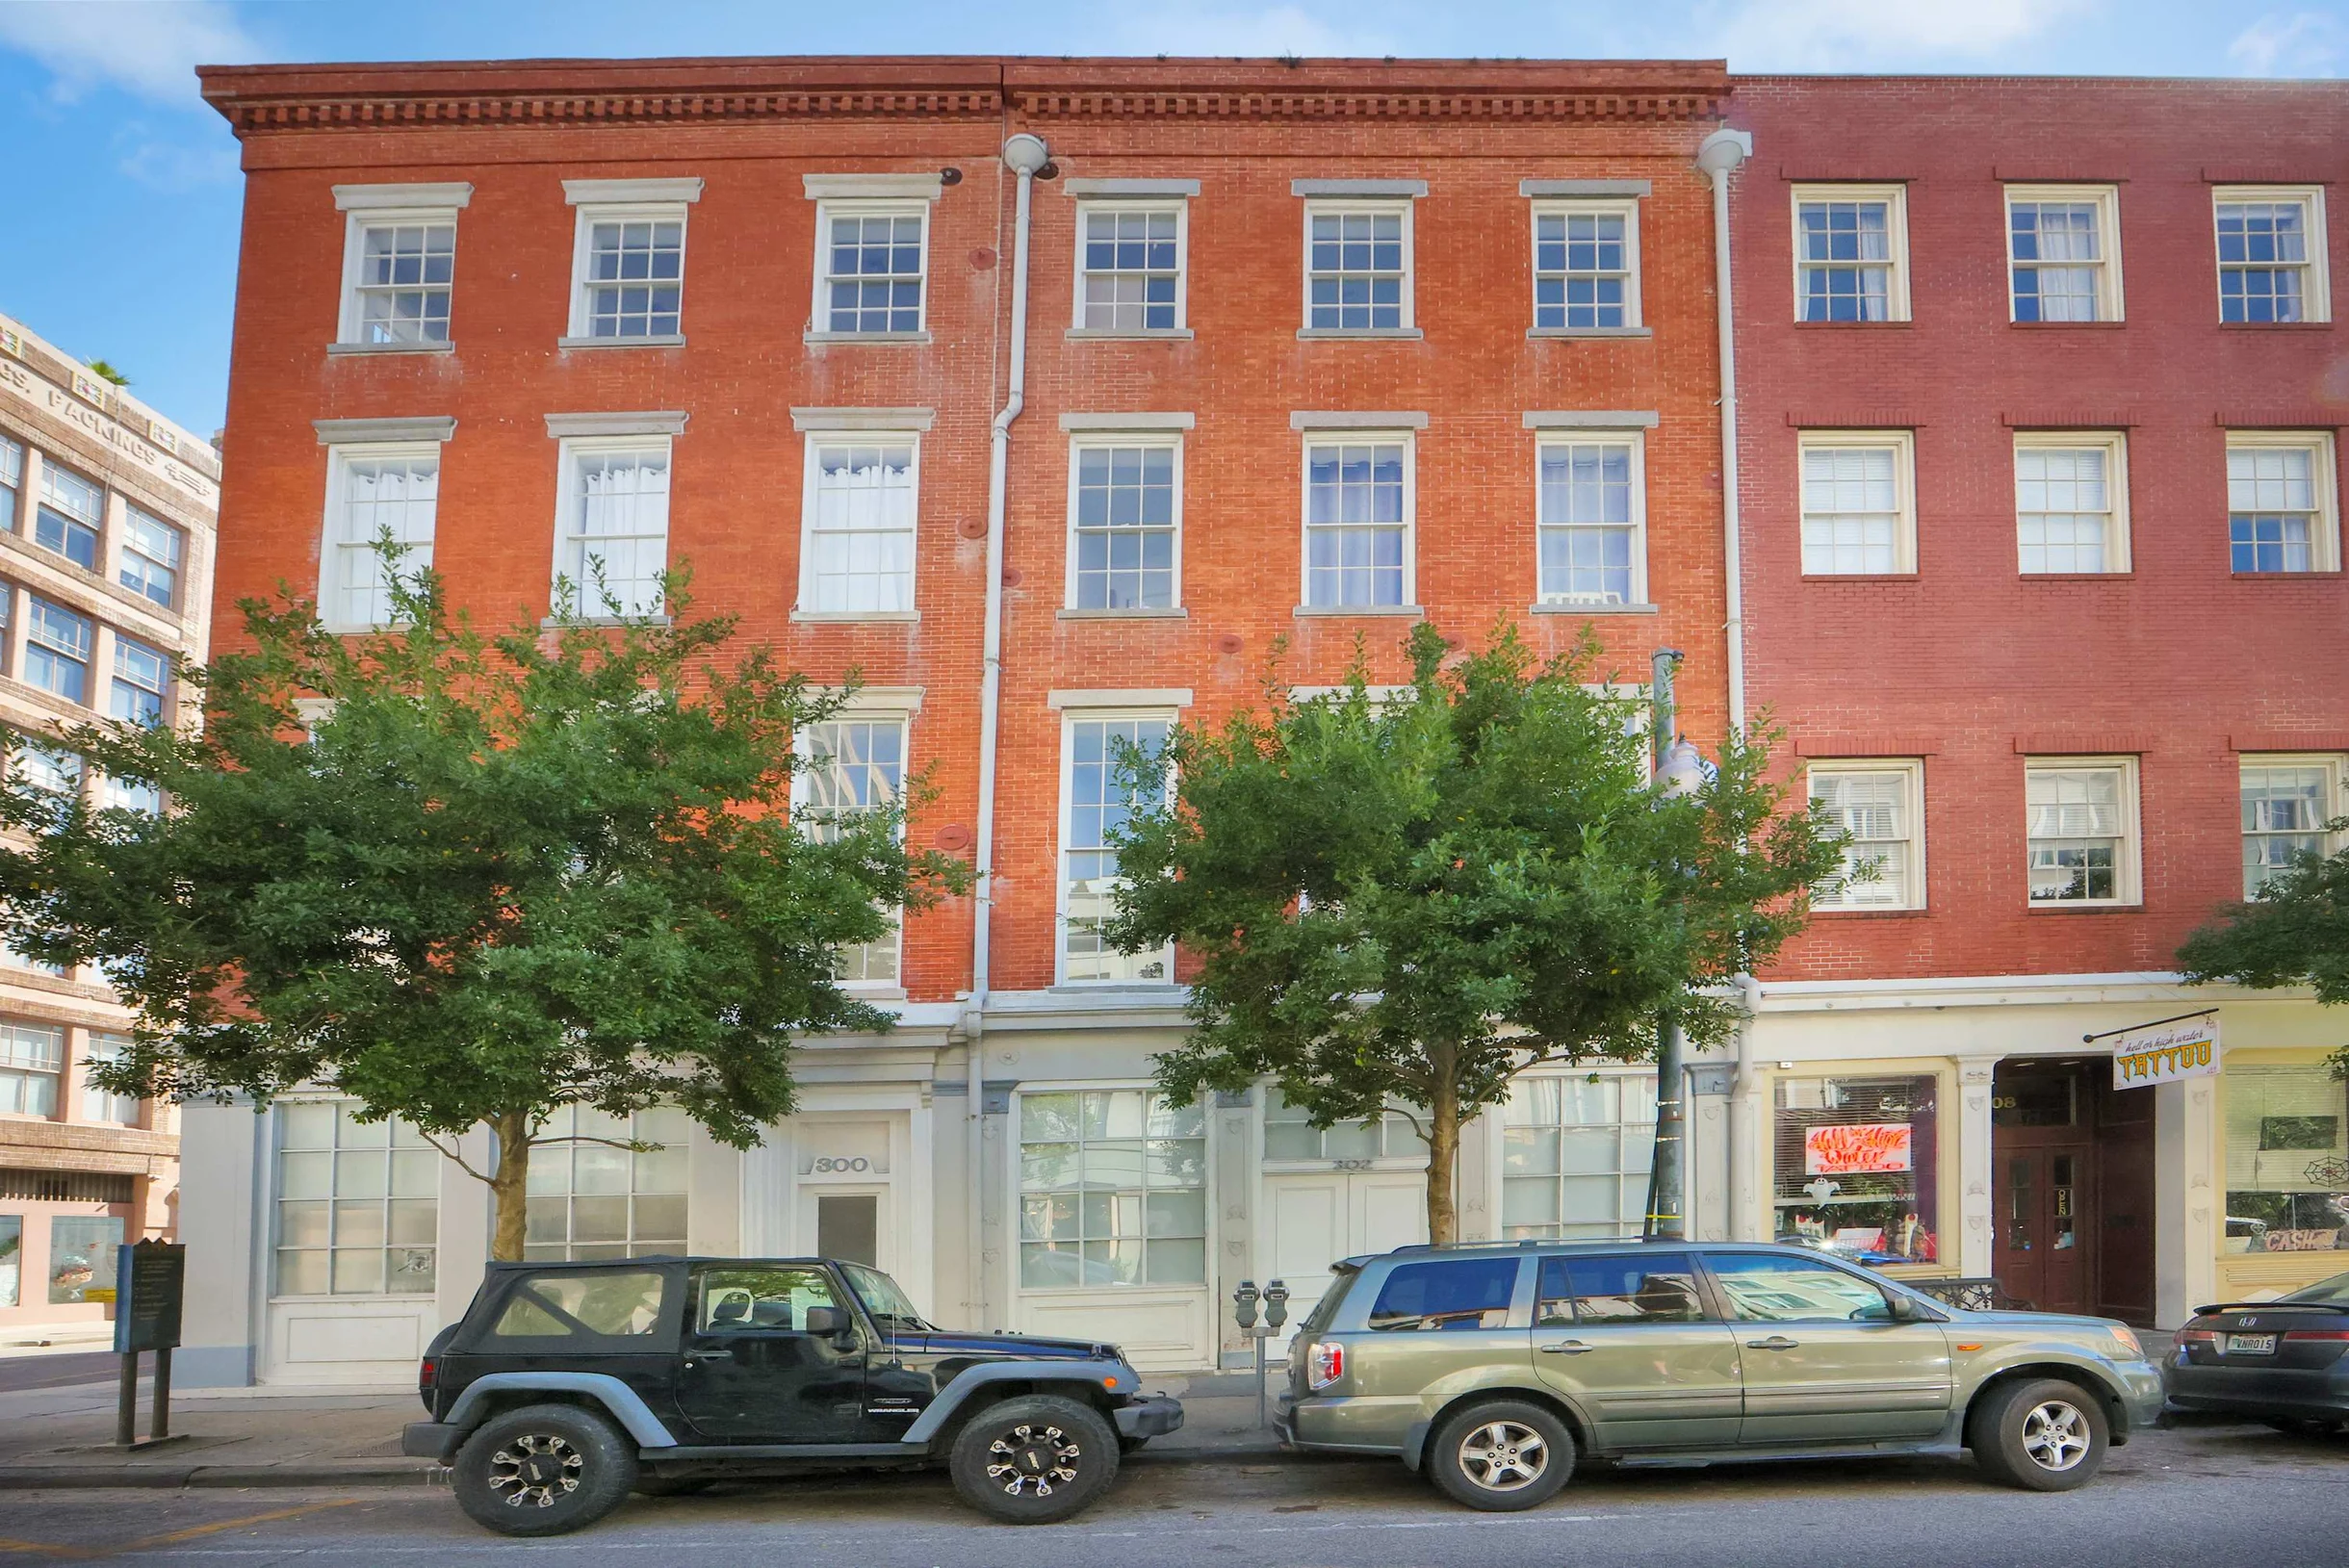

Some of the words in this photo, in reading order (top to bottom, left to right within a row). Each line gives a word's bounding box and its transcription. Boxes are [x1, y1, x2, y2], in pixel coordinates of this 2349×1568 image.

[48, 390, 156, 465] PACKINGS
[2117, 1040, 2212, 1083] TATTOO
[815, 1157, 868, 1173] 300
